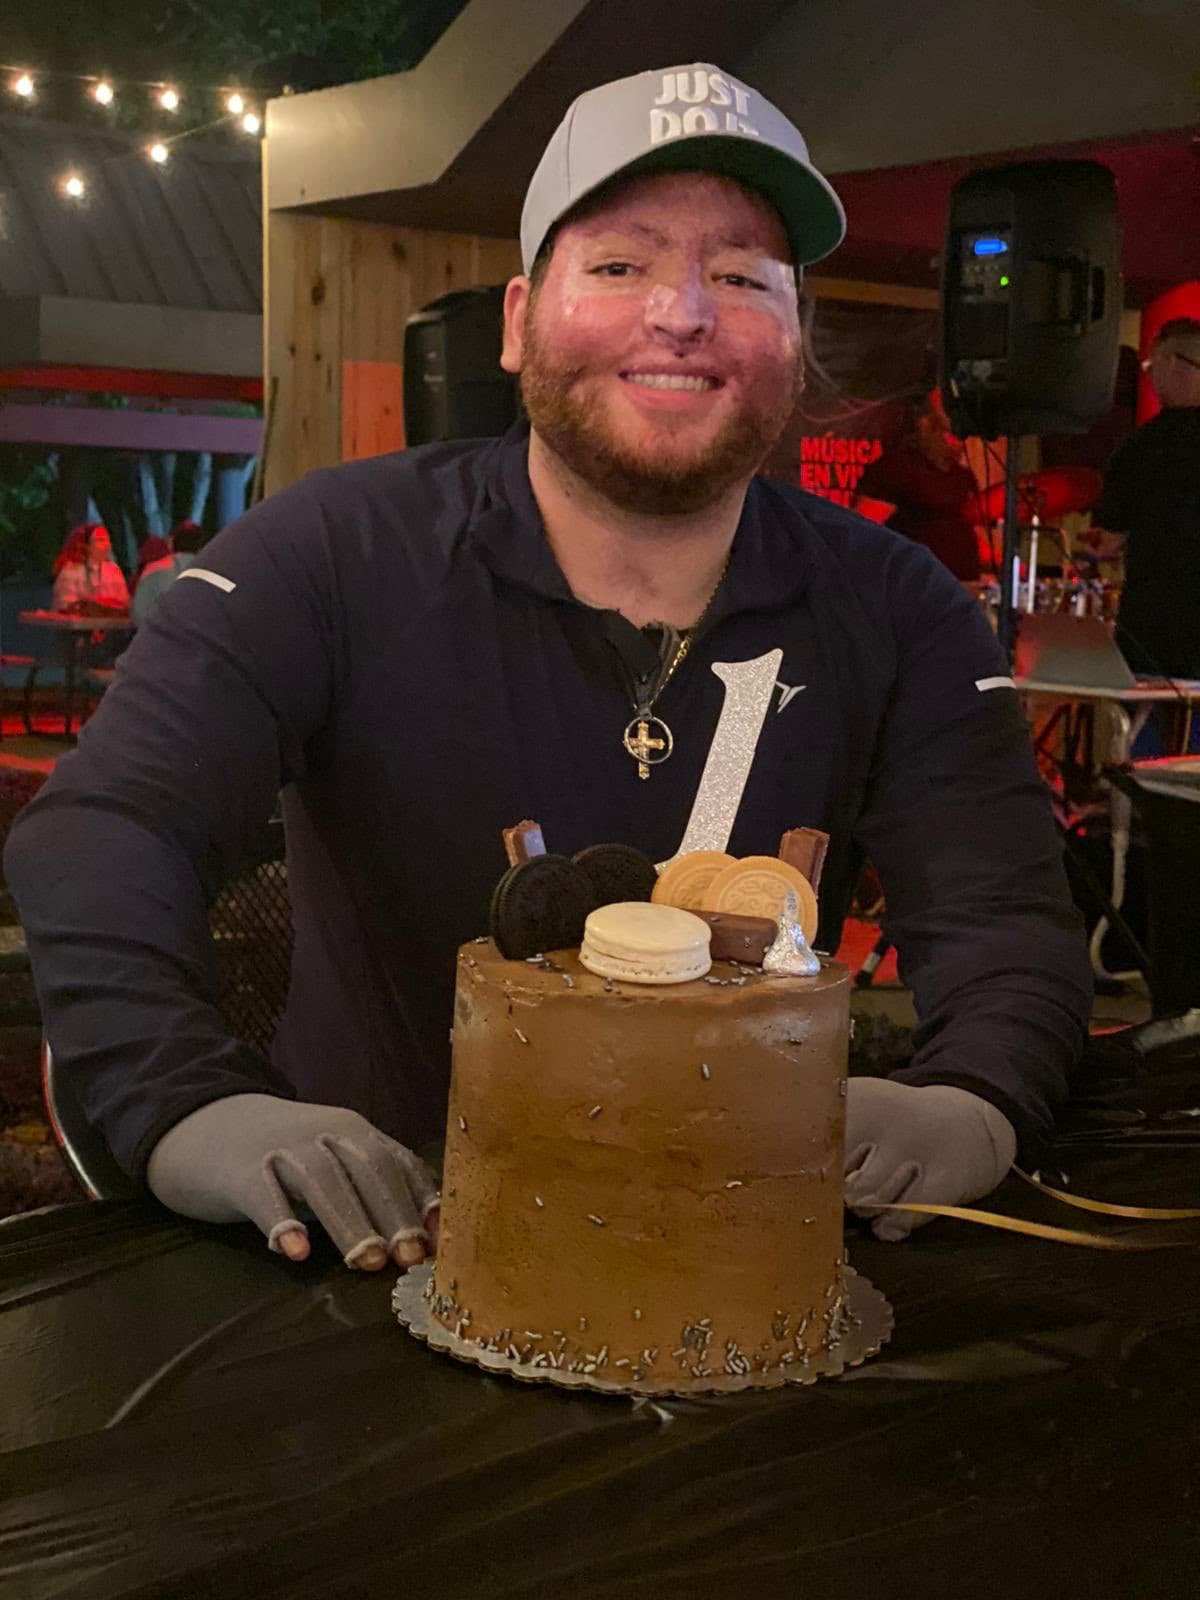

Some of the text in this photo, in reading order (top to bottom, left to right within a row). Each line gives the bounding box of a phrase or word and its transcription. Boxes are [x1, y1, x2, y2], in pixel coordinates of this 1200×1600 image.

[654, 70, 750, 116] JUST
[649, 106, 719, 144] DO
[800, 463, 831, 489] EN
[653, 647, 784, 875] 1
